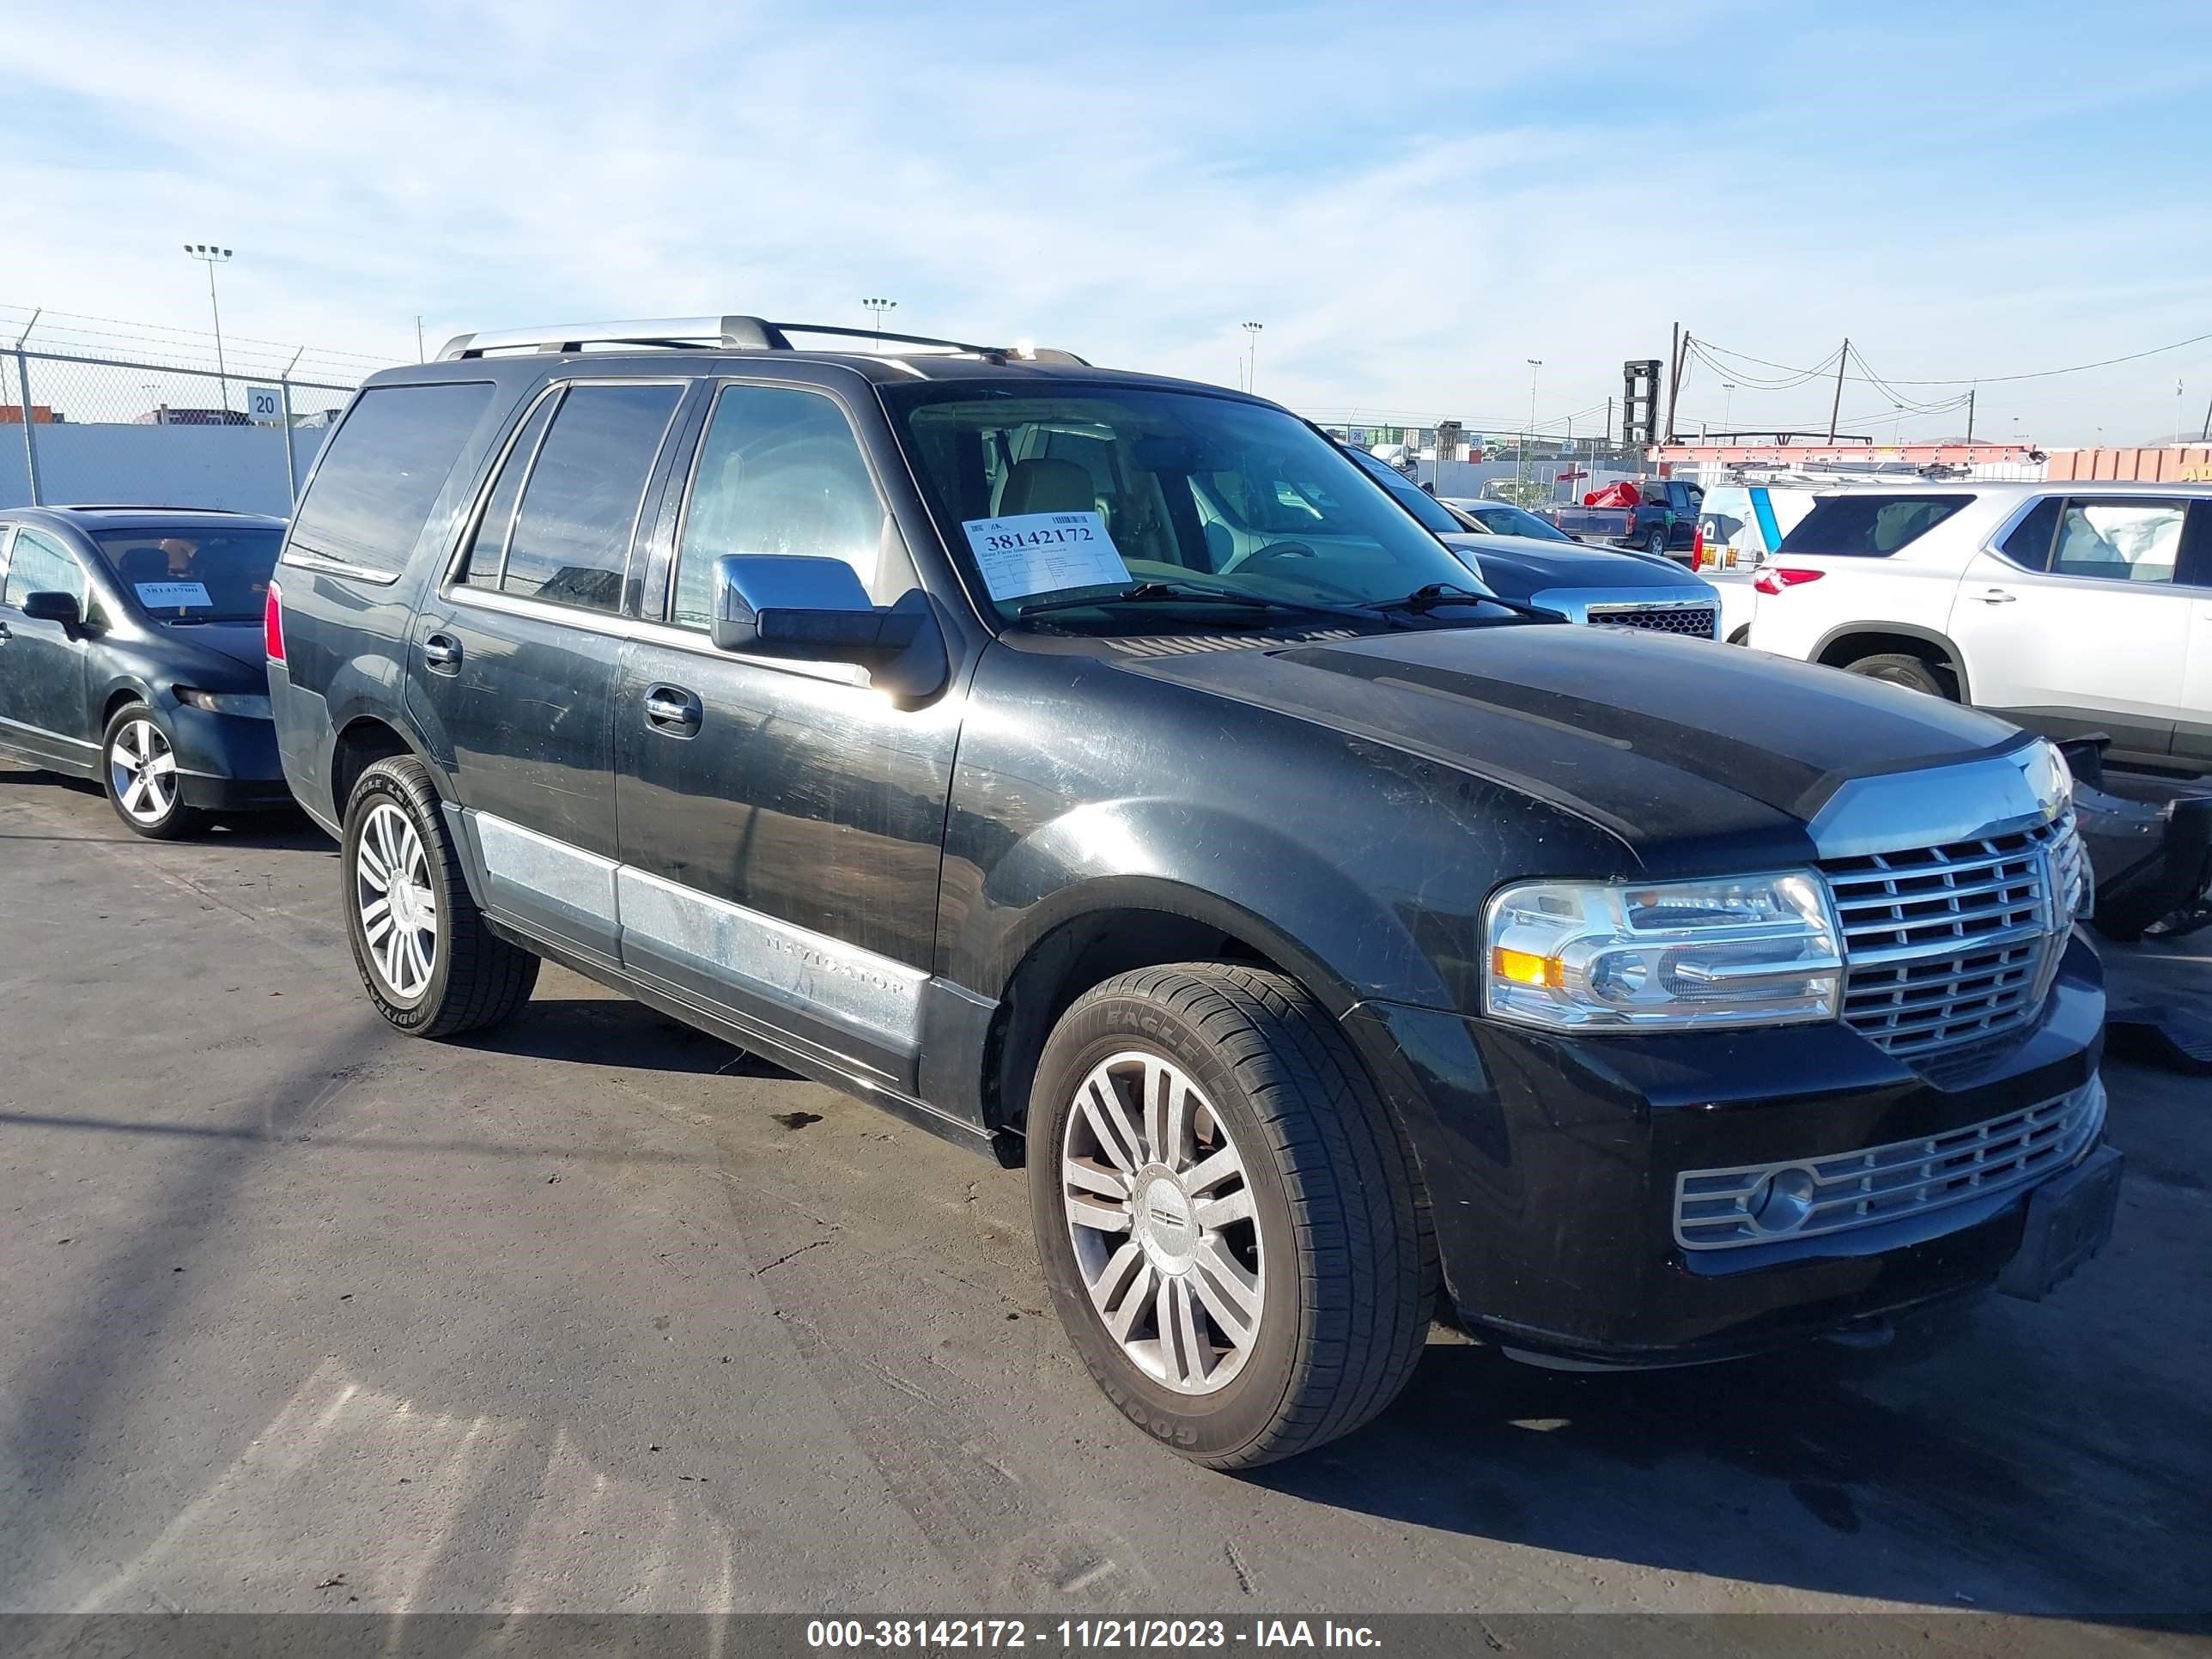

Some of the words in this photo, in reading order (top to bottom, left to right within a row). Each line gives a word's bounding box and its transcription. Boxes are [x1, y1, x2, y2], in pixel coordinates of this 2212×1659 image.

[256, 395, 275, 414] 20
[1353, 432, 1362, 441] 26
[985, 528, 1093, 551] 38142172
[766, 934, 908, 994] NAVIGATOR
[1106, 1010, 1200, 1062] EAGLE
